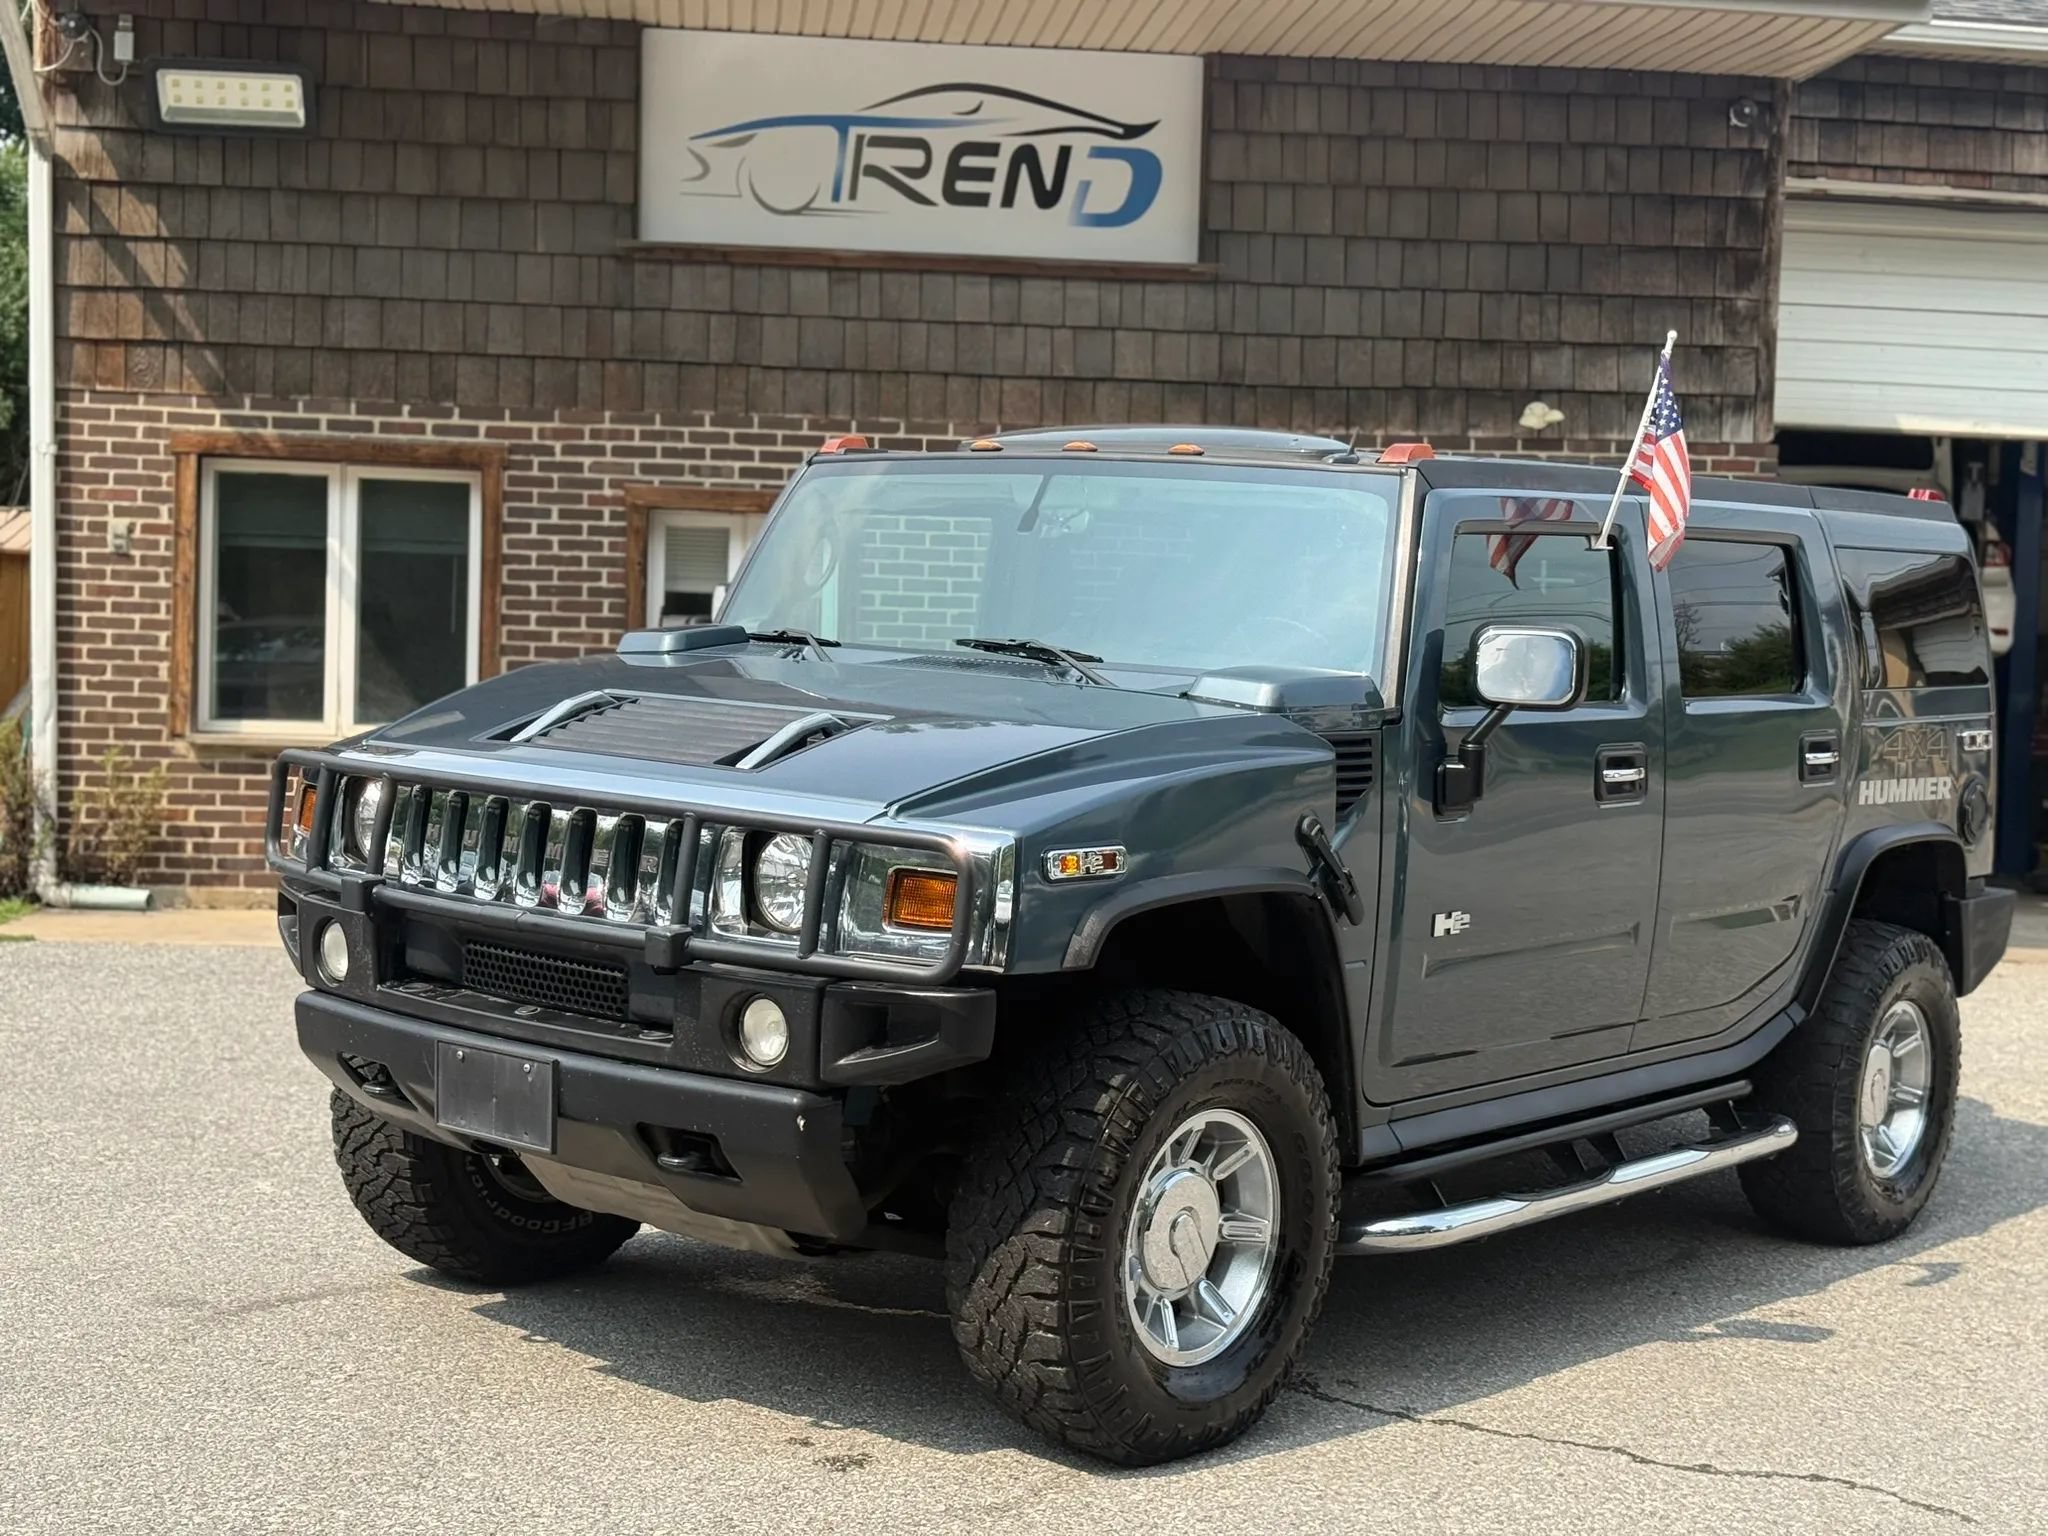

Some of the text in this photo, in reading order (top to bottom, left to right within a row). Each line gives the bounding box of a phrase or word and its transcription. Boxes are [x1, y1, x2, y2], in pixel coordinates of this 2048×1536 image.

[825, 115, 1163, 228] TREND
[1858, 776, 1953, 806] HUMMER
[425, 823, 659, 874] HUMMER
[1432, 910, 1471, 937] H2
